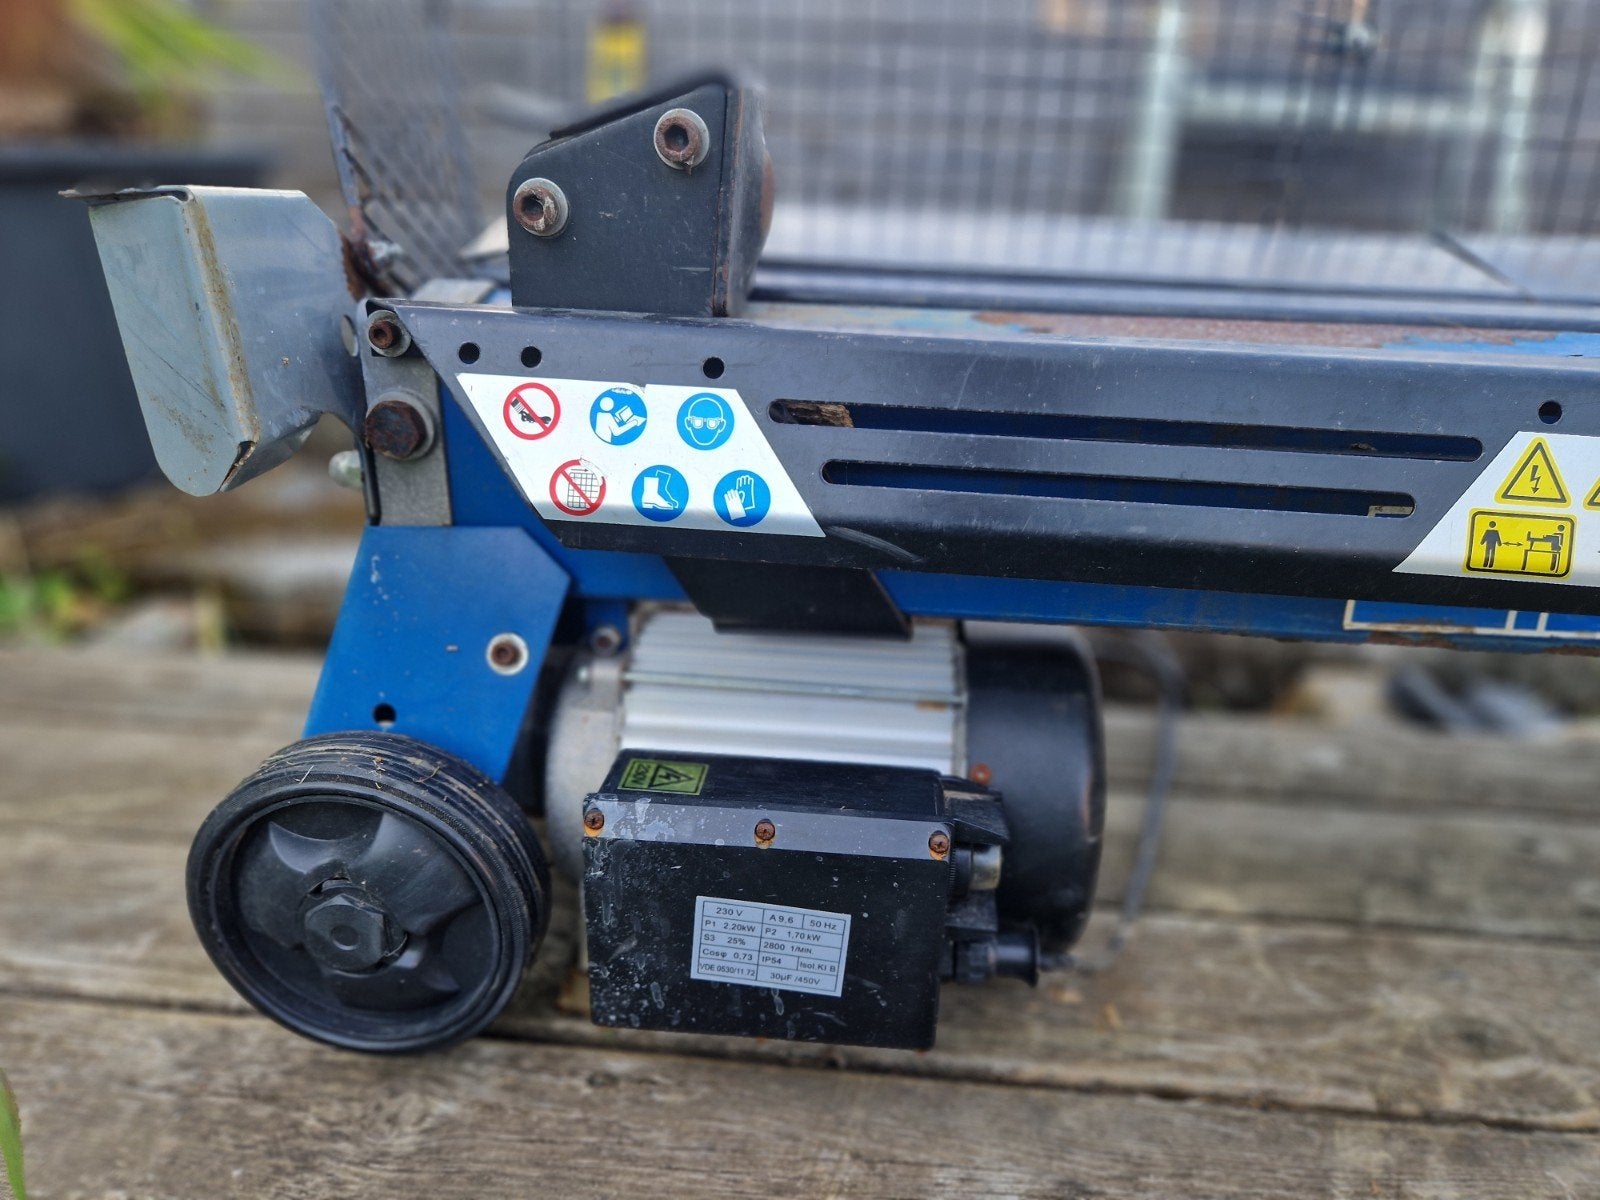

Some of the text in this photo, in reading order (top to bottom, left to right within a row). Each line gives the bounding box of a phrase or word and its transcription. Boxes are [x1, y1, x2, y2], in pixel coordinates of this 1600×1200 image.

[716, 907, 734, 916] 230
[704, 919, 716, 927] P1
[769, 914, 794, 924] A 9.6
[809, 920, 838, 930] 50 Hz
[704, 933, 746, 946] S3 25%
[765, 927, 777, 935] P2
[806, 934, 821, 942] kW
[763, 941, 786, 951] 2800
[762, 956, 782, 964] IP54
